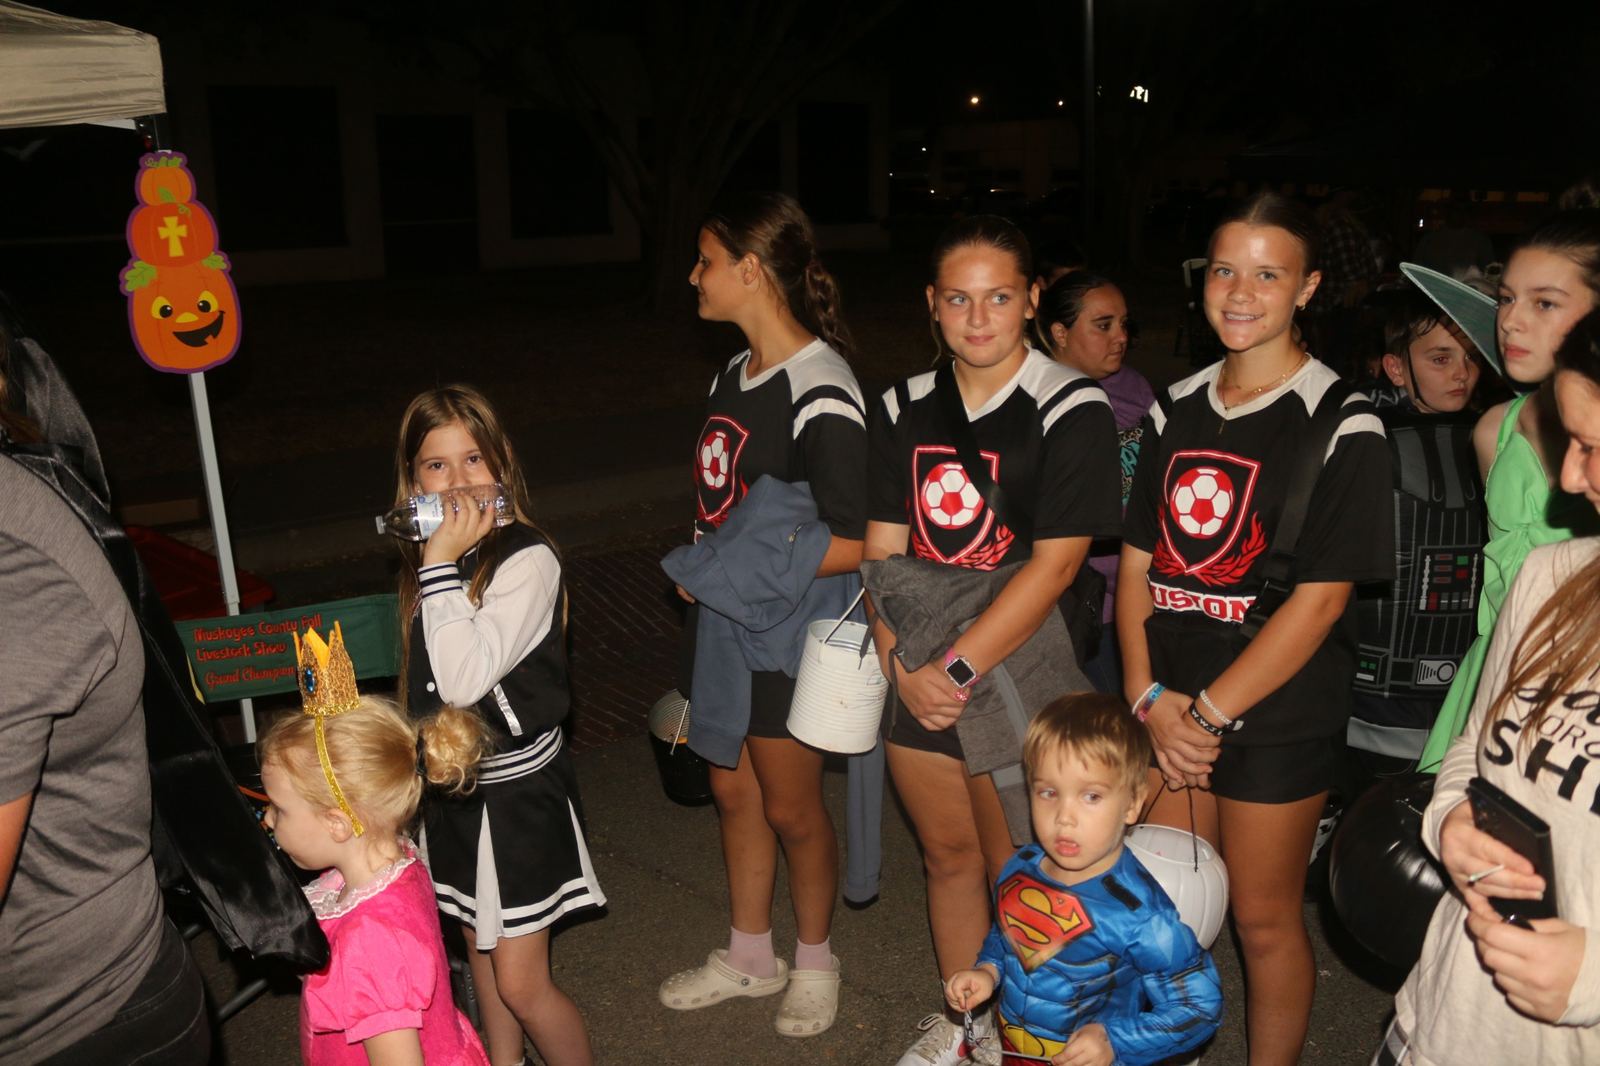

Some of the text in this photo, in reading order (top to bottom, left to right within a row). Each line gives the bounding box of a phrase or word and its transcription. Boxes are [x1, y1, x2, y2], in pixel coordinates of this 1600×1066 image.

[1148, 581, 1257, 624] USION
[194, 626, 255, 642] Muskogee
[196, 641, 287, 662] Livestock Show
[205, 671, 240, 687] Grand
[1483, 718, 1600, 816] SH
